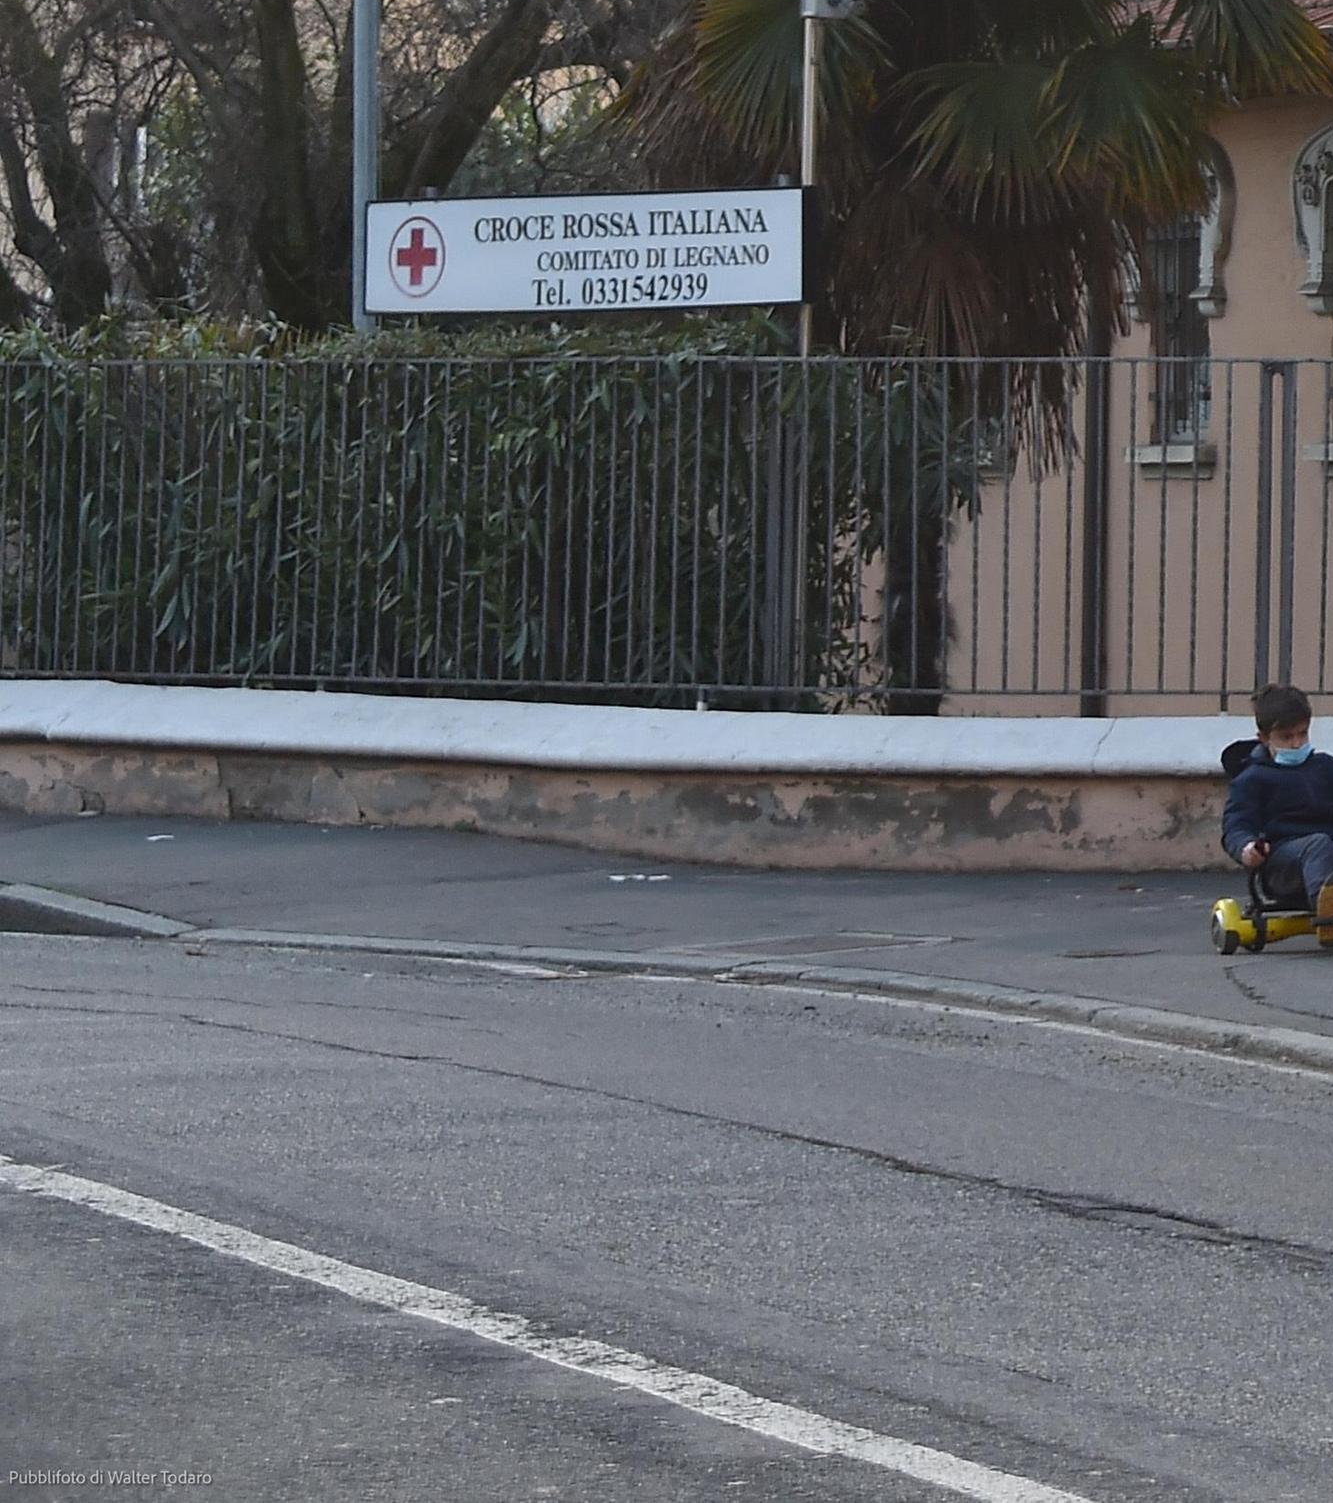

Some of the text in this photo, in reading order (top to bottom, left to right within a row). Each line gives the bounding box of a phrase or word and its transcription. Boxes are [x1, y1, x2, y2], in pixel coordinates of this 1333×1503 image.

[475, 208, 769, 242] CROCE ROSSA ITALIANA
[537, 244, 770, 272] COMITATO DI LEGNANO
[532, 273, 709, 306] Tel. 0331542939
